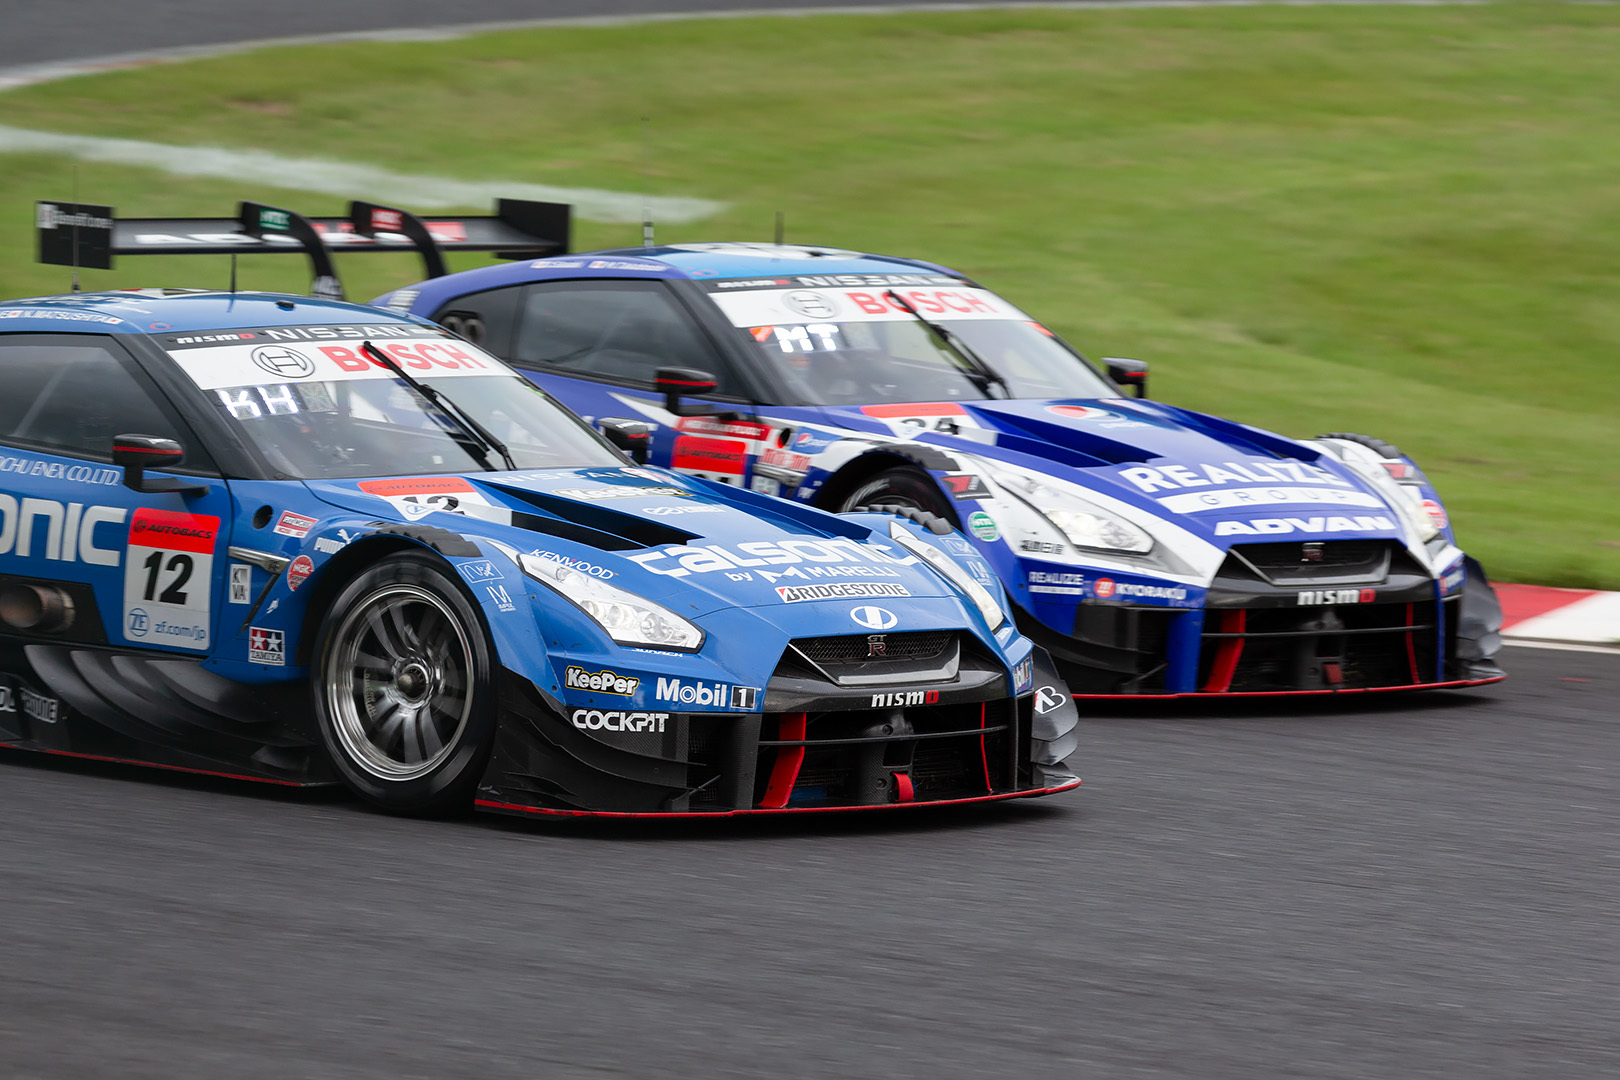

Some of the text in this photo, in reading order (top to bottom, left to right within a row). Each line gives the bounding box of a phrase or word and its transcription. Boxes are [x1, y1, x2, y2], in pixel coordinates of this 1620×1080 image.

[798, 276, 934, 287] NISSAN
[845, 290, 999, 315] BOSCH
[176, 332, 257, 345] nismo
[264, 325, 409, 342] NISSAN
[773, 323, 840, 353] MT
[317, 342, 487, 373] BOSCH
[218, 384, 299, 419] KH
[386, 482, 465, 491] AUTOBACS
[1118, 461, 1356, 493] REALIZE
[147, 523, 213, 540] AUTOBACS
[1214, 516, 1398, 536] ADVAN
[529, 548, 616, 580] KENWOOD
[143, 551, 194, 605] 12
[724, 565, 901, 583] by MARELLI
[780, 584, 910, 603] BRIDGESTONE
[1297, 589, 1376, 606] nismo
[154, 621, 207, 640] zf.com/jp
[251, 650, 283, 662] TAMIYA
[567, 667, 639, 695] KeePer
[656, 677, 728, 708] Mobil
[871, 690, 940, 707] nismo
[572, 708, 670, 733] COCKPIT
